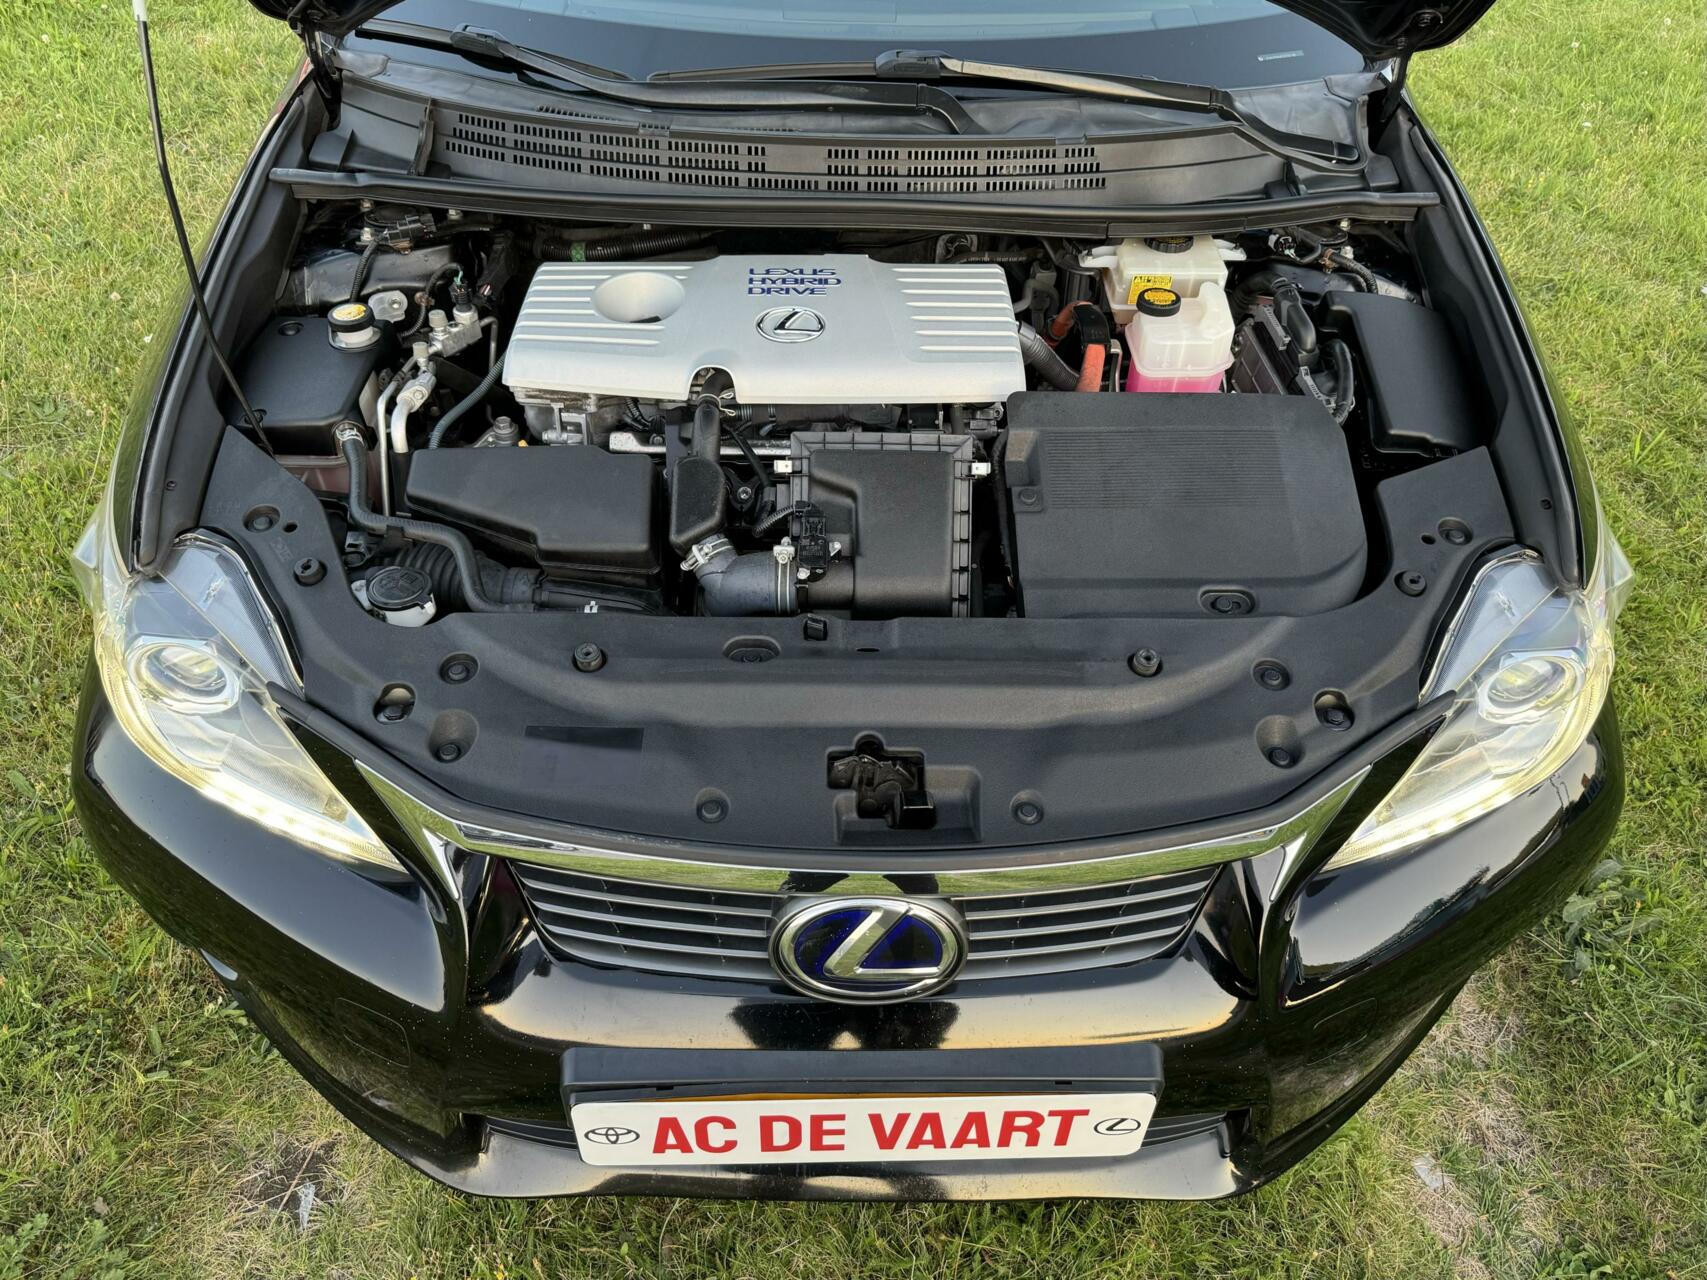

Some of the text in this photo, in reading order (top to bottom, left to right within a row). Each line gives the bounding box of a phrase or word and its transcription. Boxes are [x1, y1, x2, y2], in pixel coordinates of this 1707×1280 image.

[749, 268, 836, 276] LEXUS
[748, 277, 842, 285] HYBRID
[747, 287, 827, 295] DRIVE
[653, 1109, 1090, 1154] AC DE VAART
